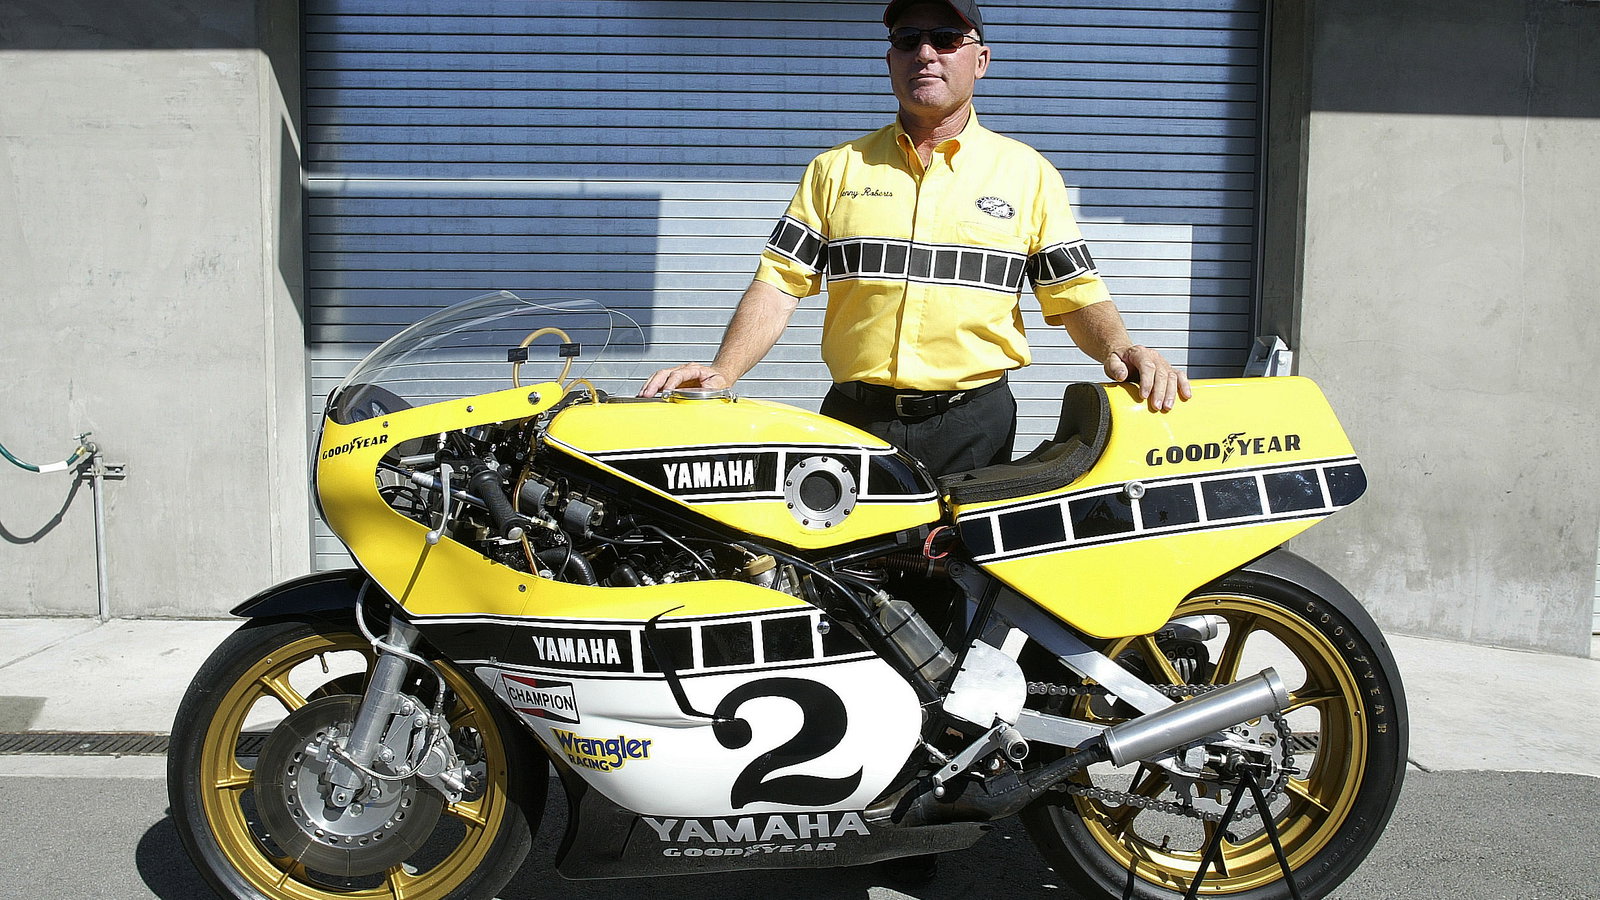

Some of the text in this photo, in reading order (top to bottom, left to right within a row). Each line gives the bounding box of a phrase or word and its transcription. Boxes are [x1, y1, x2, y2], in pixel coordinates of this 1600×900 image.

[322, 434, 388, 460] GOODYEAR
[1145, 432, 1301, 466] GOODYEAR
[662, 459, 755, 490] YAMAHA
[532, 635, 622, 665] YAMAHA
[508, 686, 574, 711] CHAMPION
[552, 728, 652, 768] Wrangler
[711, 676, 864, 810] 2
[569, 754, 610, 771] RACING
[641, 812, 871, 843] YAMAHA
[662, 842, 837, 858] GOODYEAR
